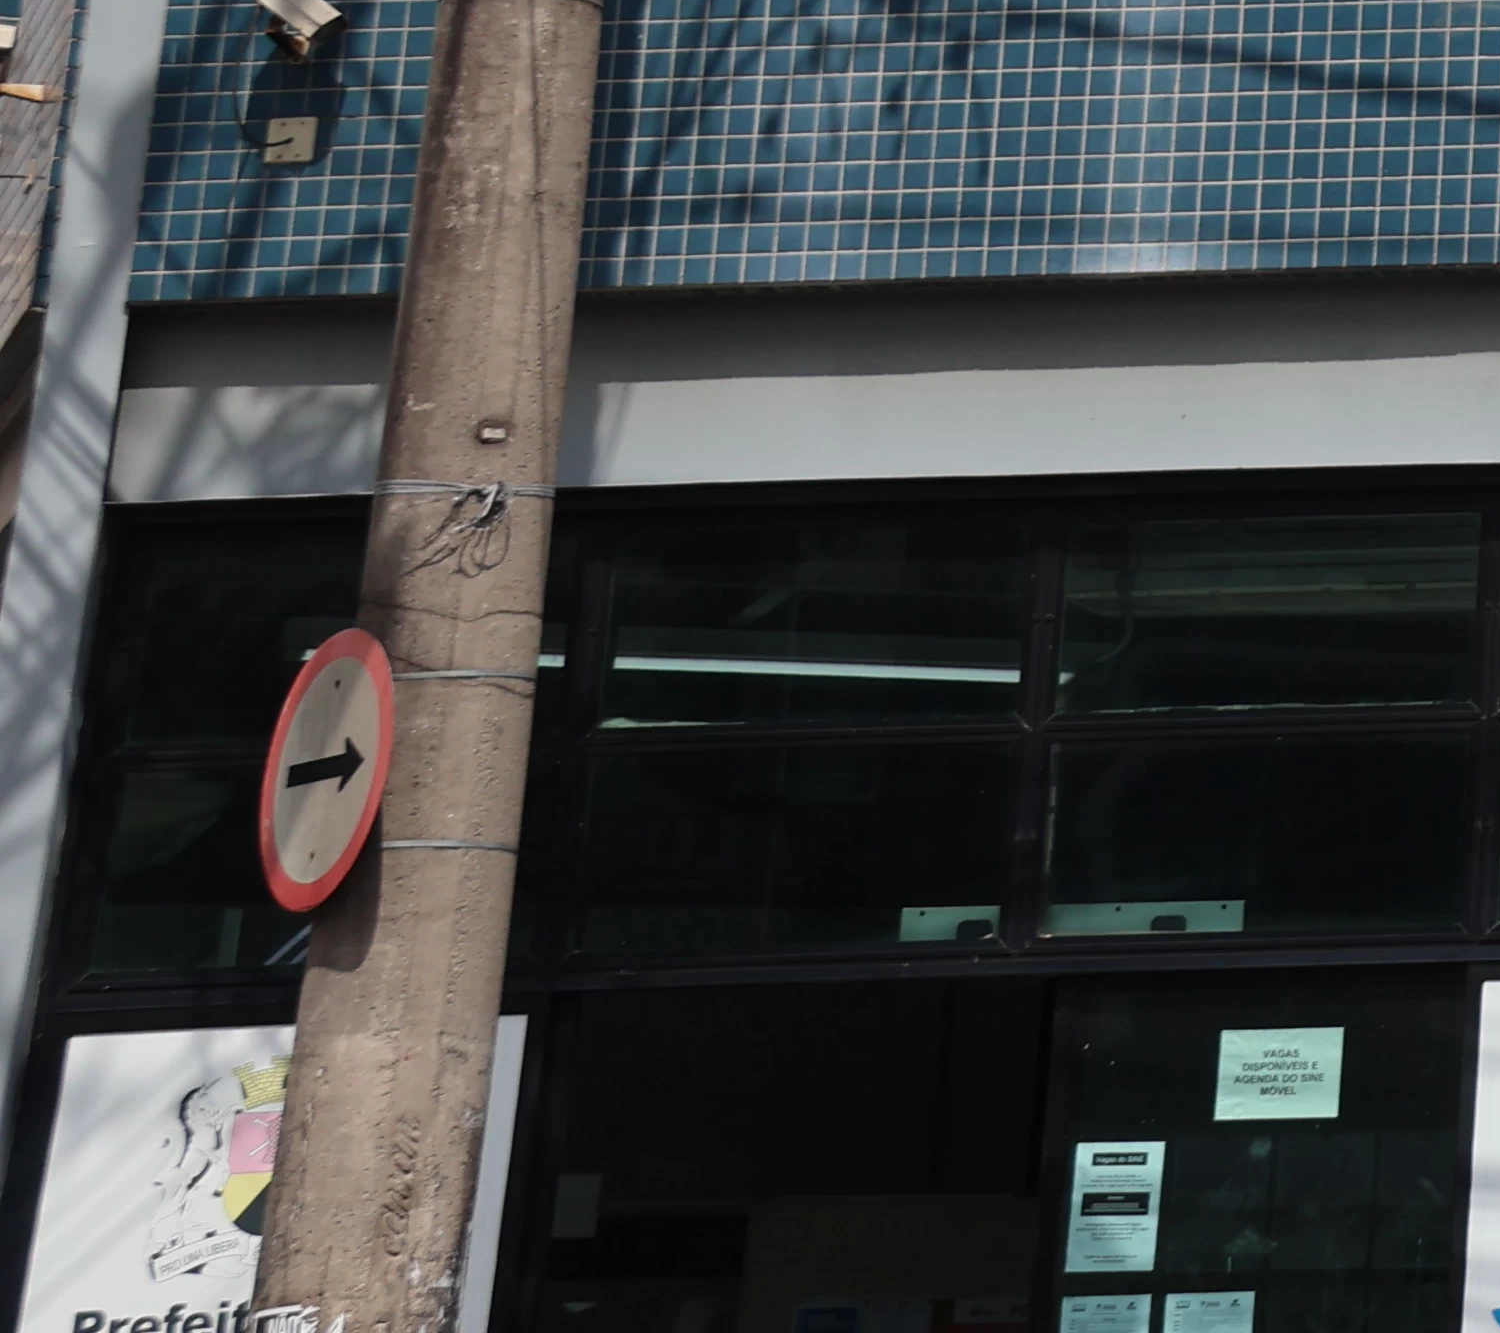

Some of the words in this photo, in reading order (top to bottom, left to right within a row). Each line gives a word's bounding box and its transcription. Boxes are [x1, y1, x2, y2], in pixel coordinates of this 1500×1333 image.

[1262, 1048, 1301, 1059] VAGAS
[1311, 1060, 1320, 1070] E
[1233, 1074, 1279, 1084] AGENDA
[1282, 1073, 1299, 1083] DO
[1300, 1072, 1326, 1082] SINE
[1259, 1084, 1297, 1096] MÓVEL
